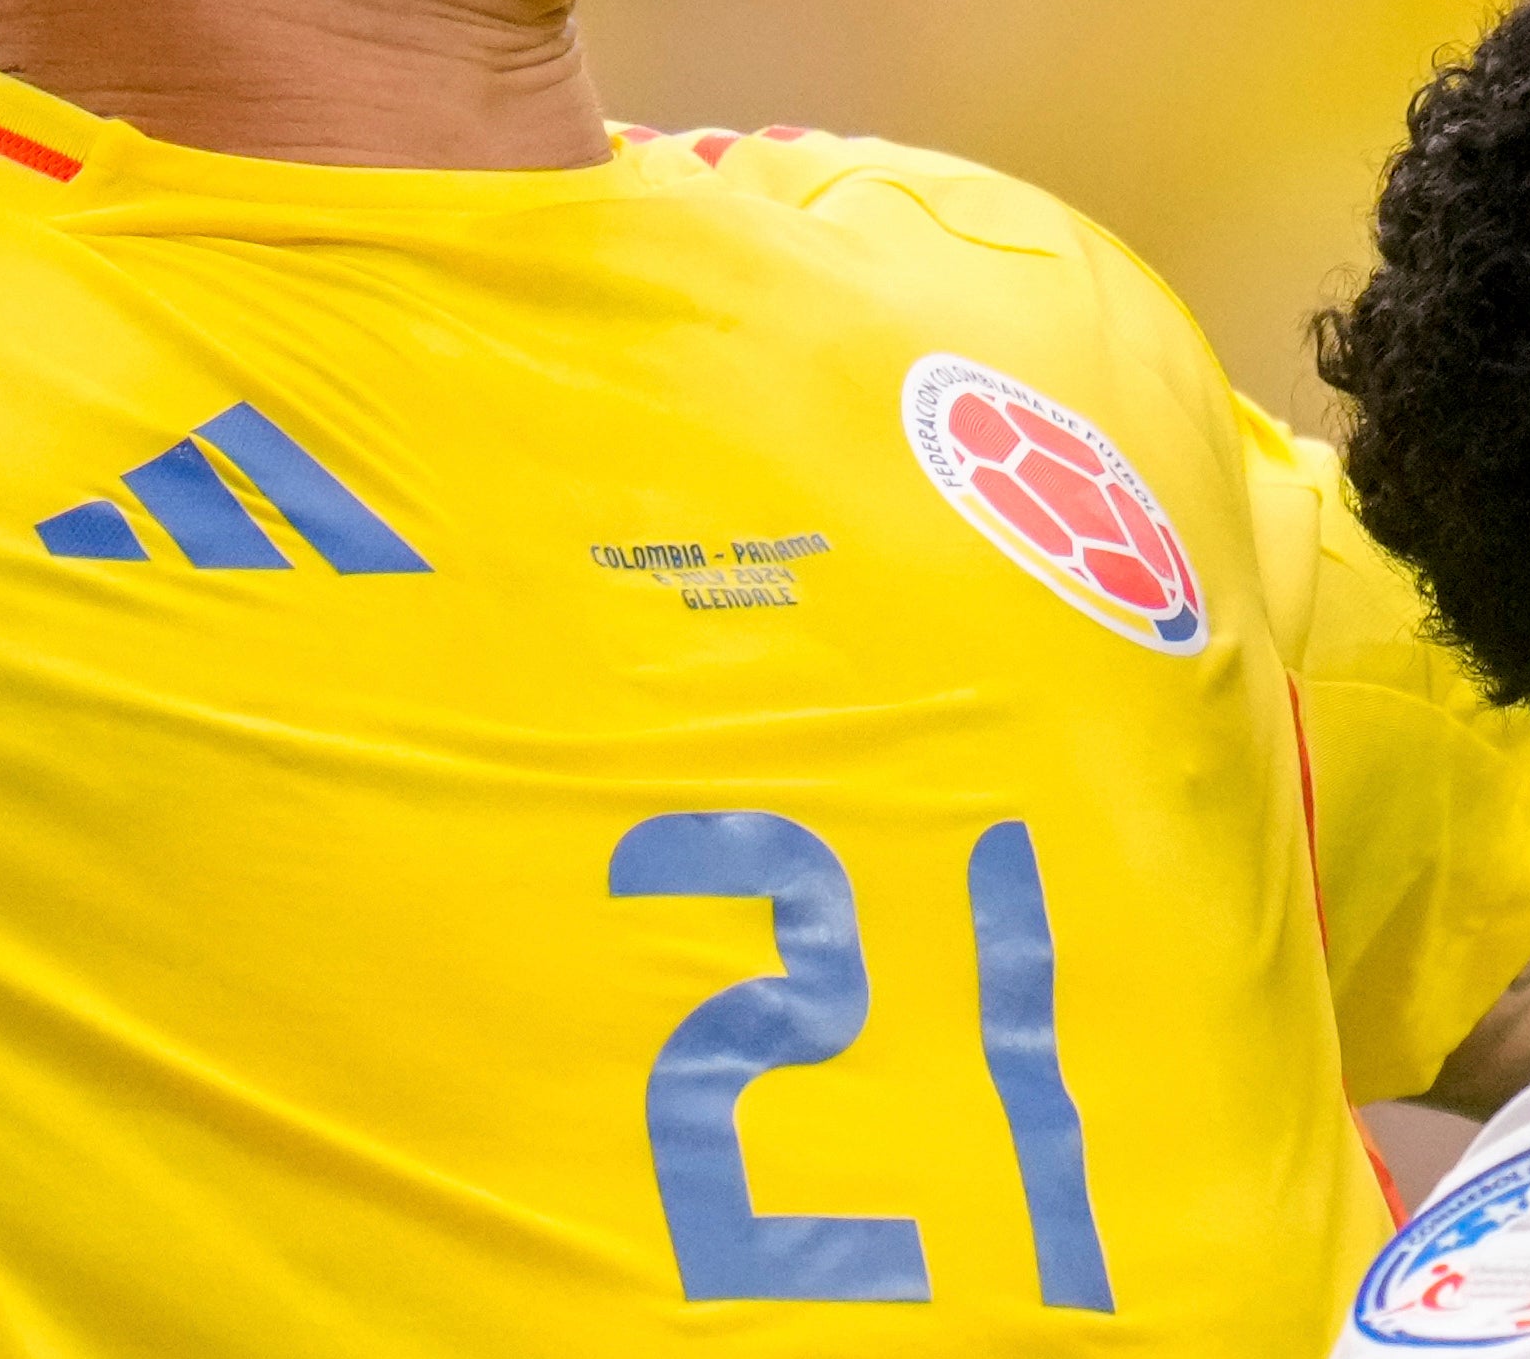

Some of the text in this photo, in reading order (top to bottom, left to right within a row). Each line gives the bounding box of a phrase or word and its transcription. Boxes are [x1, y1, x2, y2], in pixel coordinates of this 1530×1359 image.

[930, 365, 1046, 415] COLOMBIANA
[916, 379, 963, 488] FEDERACION
[1051, 409, 1080, 432] DE
[590, 543, 706, 570] COLOMBIA
[730, 533, 831, 565] PANAMA
[674, 569, 727, 585] JULY
[730, 566, 796, 586] 2024
[680, 586, 799, 610] GLENDALE
[608, 809, 1116, 1315] 21
